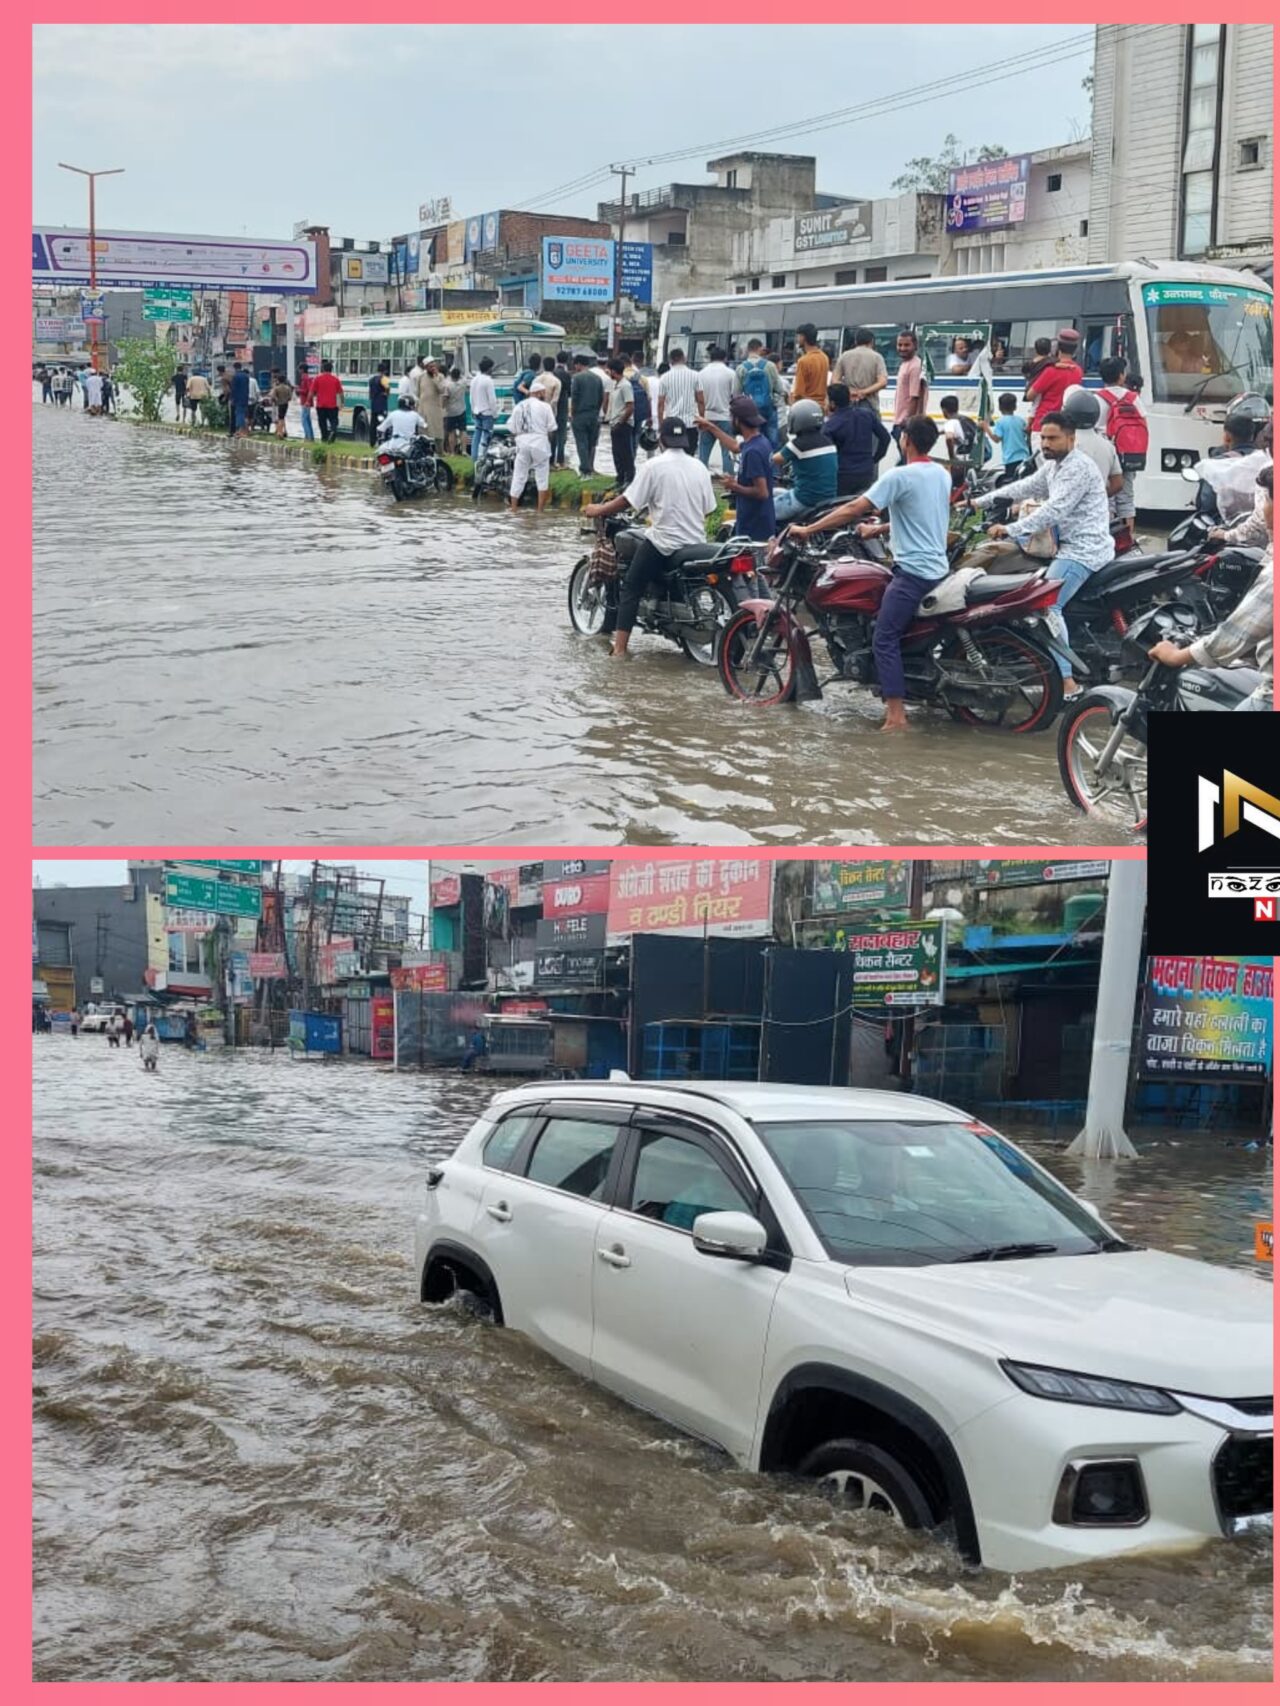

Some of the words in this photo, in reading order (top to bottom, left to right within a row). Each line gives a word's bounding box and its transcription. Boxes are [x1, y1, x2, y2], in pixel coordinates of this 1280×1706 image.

[800, 214, 833, 235] SUMIT
[565, 243, 609, 258] GEETA
[565, 257, 609, 267] UNIVERSITY
[1153, 1004, 1182, 1026] हमारे
[1251, 1017, 1267, 1035] का
[1147, 1034, 1178, 1053] ताजा
[1181, 1032, 1216, 1054] चिकन
[1219, 1036, 1257, 1058] मिलता
[1258, 1037, 1267, 1058] है
